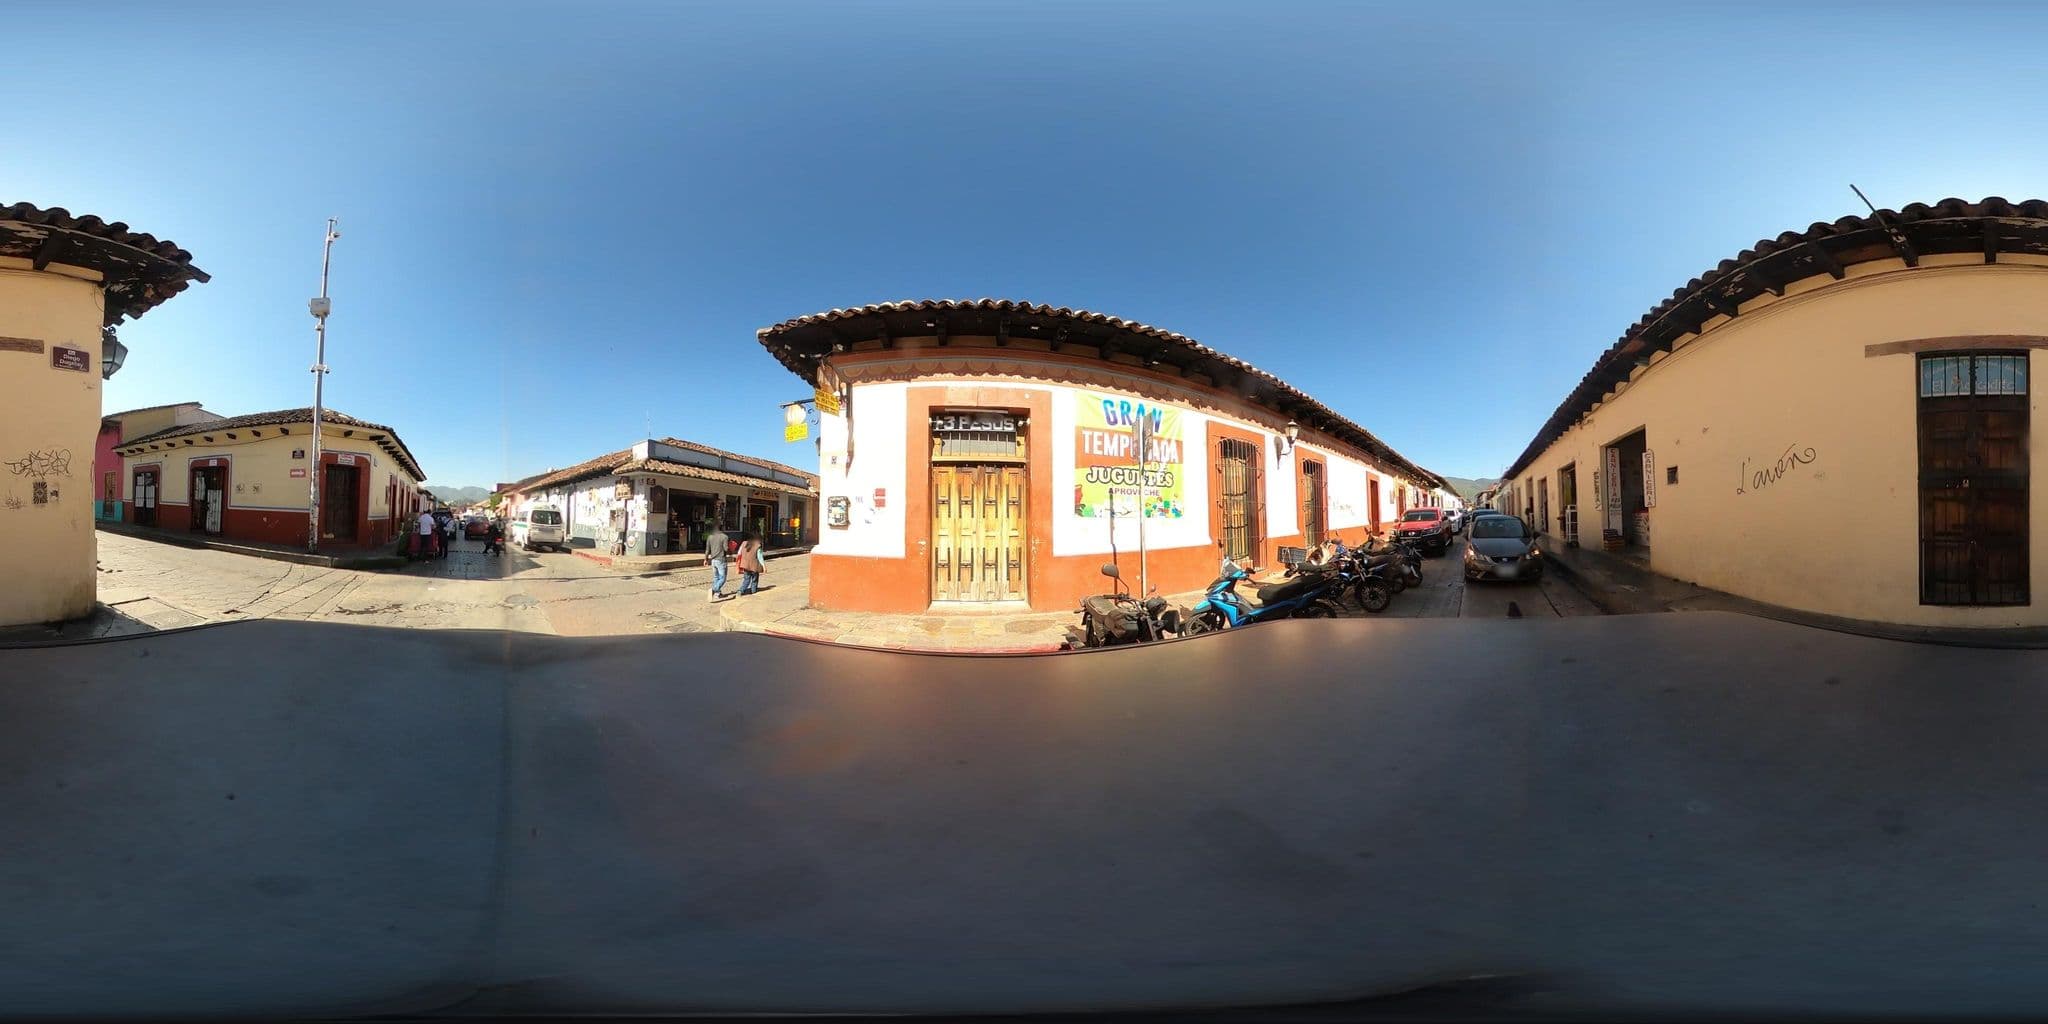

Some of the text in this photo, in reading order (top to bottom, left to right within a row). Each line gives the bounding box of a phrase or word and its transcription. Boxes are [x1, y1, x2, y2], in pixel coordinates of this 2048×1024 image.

[1103, 399, 1162, 432] GRAN
[1082, 430, 1179, 464] TEMPADA
[1644, 453, 1653, 506] CARNICERIA
